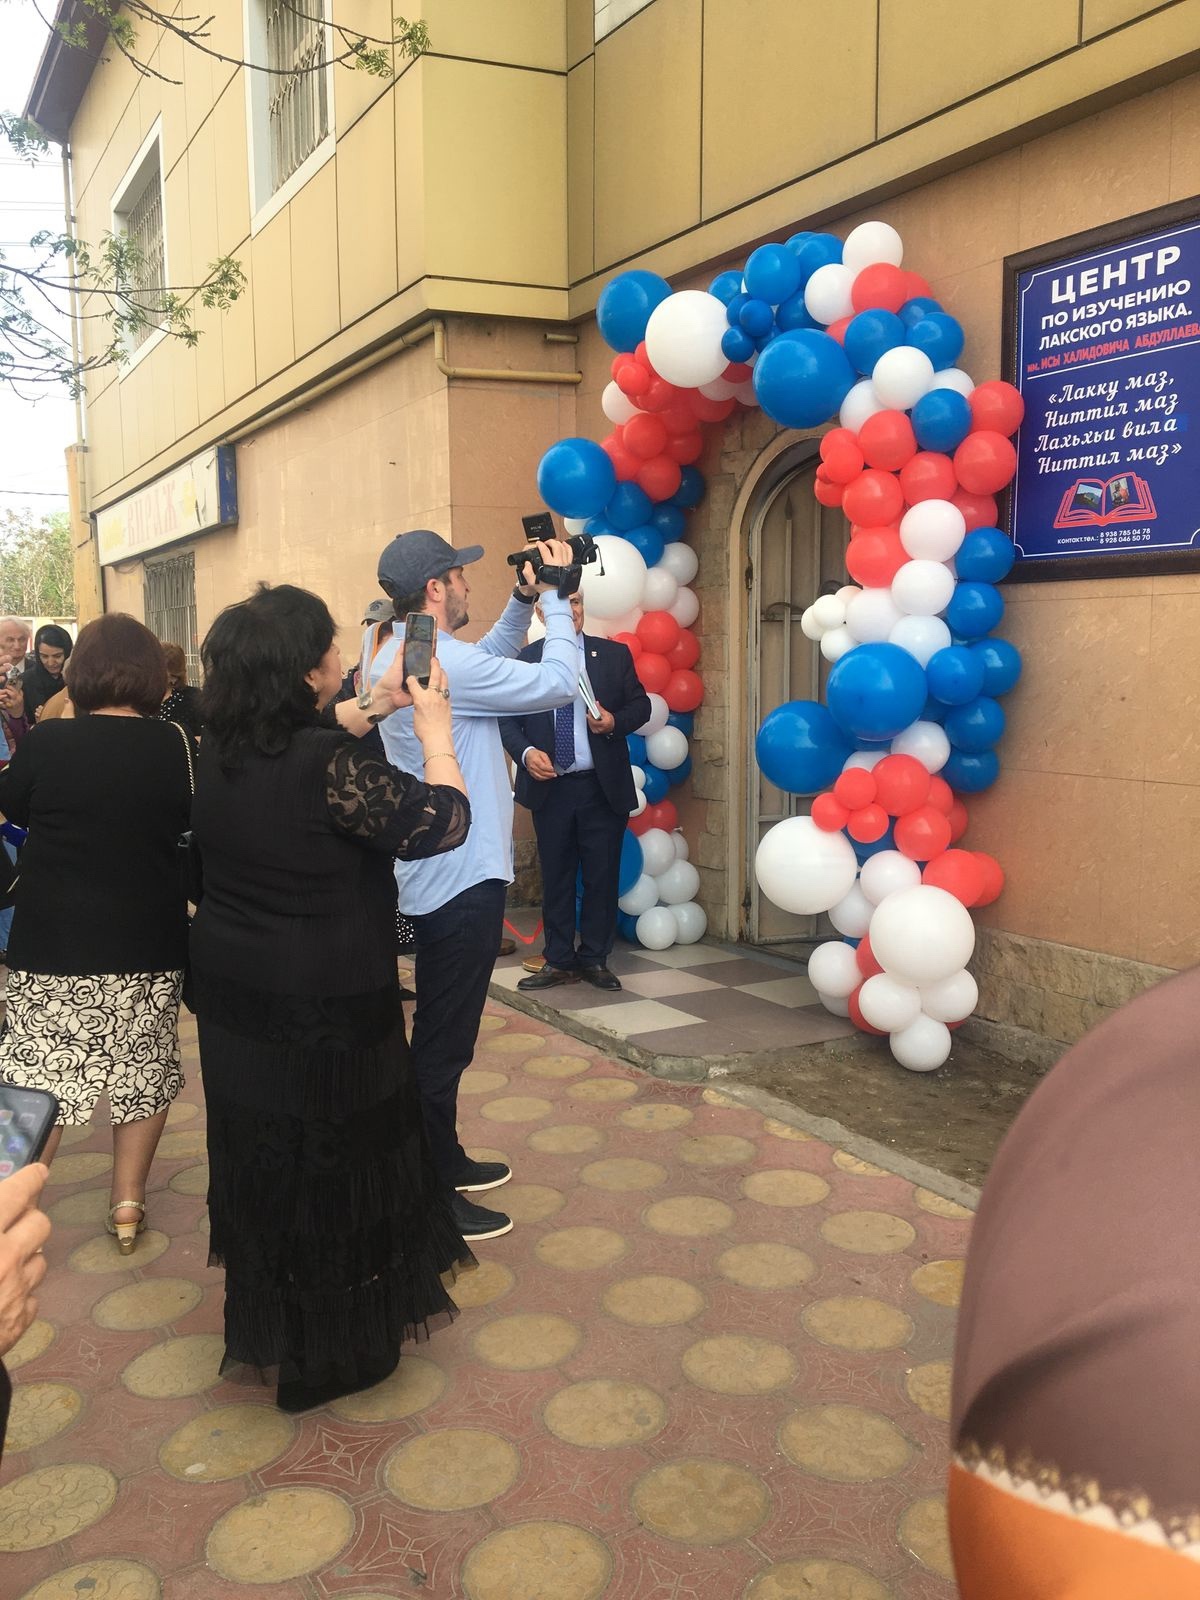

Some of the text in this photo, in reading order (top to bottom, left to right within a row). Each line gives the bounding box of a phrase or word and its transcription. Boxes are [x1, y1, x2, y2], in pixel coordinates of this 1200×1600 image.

[1051, 245, 1181, 304] ЦЕНТР
[1041, 279, 1191, 330] ПО ИЗУЧЕНИЮ
[1039, 302, 1192, 350] ЛАКСКОГО ЯЗЫКА.
[1041, 352, 1060, 369] ИСЫ
[1063, 339, 1129, 363] ХАЛИДОВИЧА
[1048, 371, 1174, 404] «Лакку маз,
[1045, 394, 1178, 429] Ниттил маз
[1034, 419, 1177, 453] Лахьхьи вила
[1038, 442, 1182, 474] Ниттил маз»
[128, 480, 177, 547] ВИРАЖ
